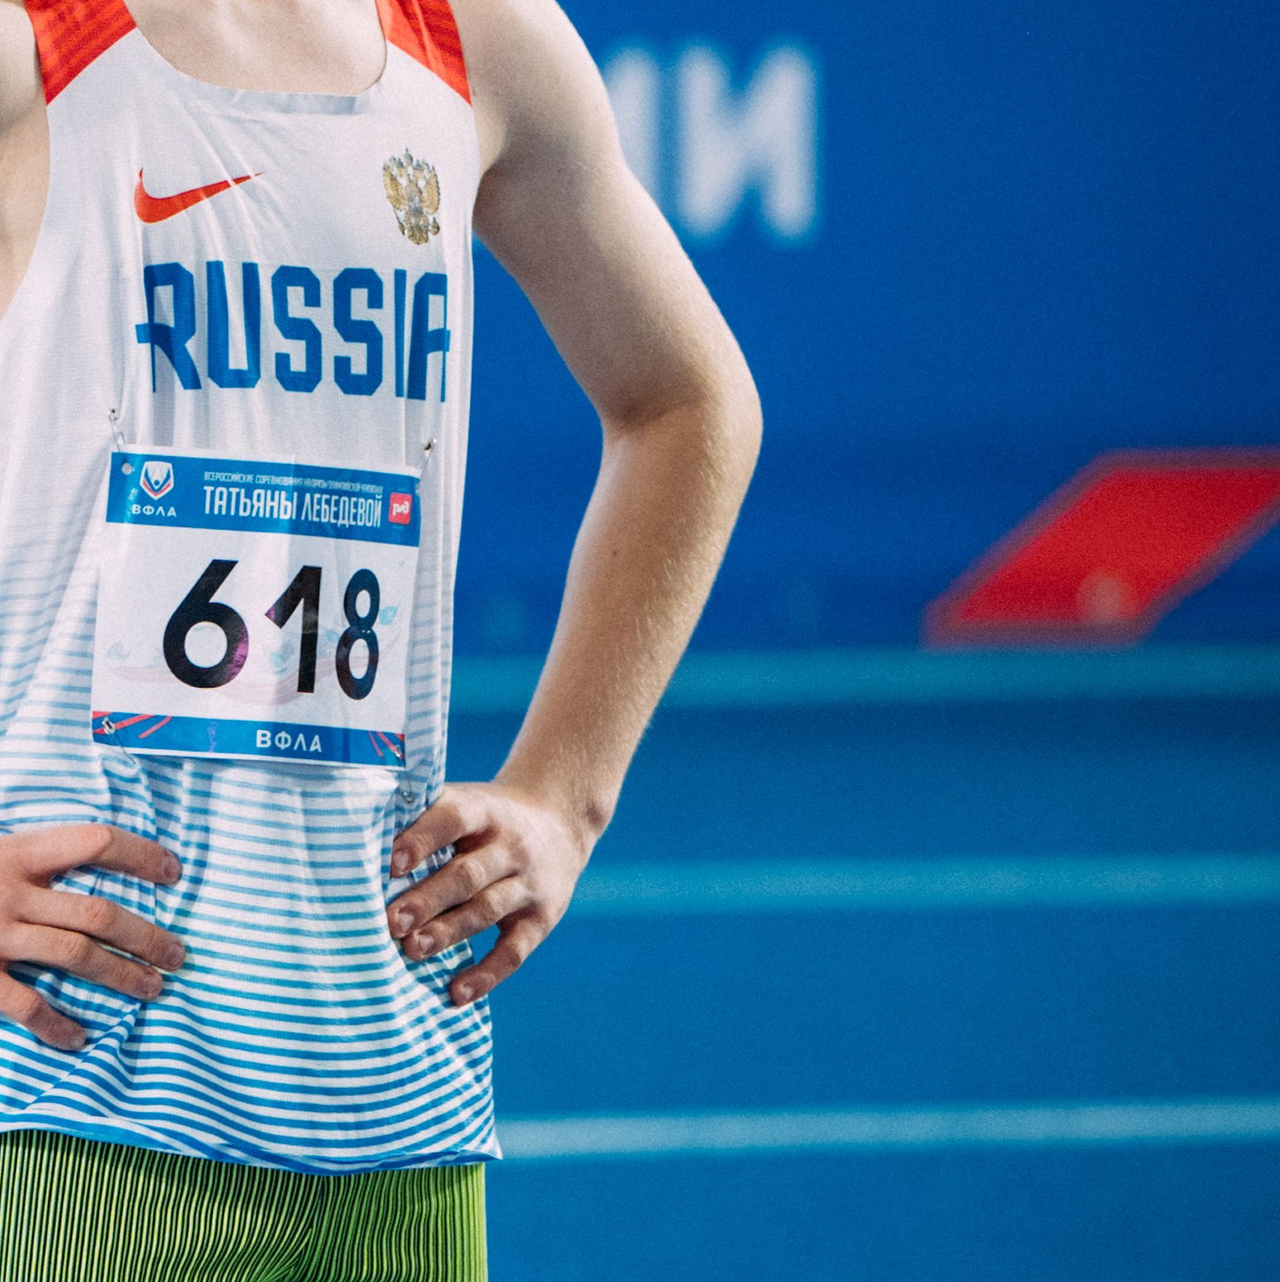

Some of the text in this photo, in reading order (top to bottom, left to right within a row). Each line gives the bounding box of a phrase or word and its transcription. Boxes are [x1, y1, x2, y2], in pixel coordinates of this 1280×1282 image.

[135, 260, 451, 403] RUSSIA
[131, 504, 177, 518] ВФЛА
[203, 485, 298, 520] ТАТЬЯНЫ
[301, 492, 383, 528] ЛЕБЕДЕВОЙ
[163, 558, 380, 700] 618
[256, 729, 322, 753] ВФЛА
